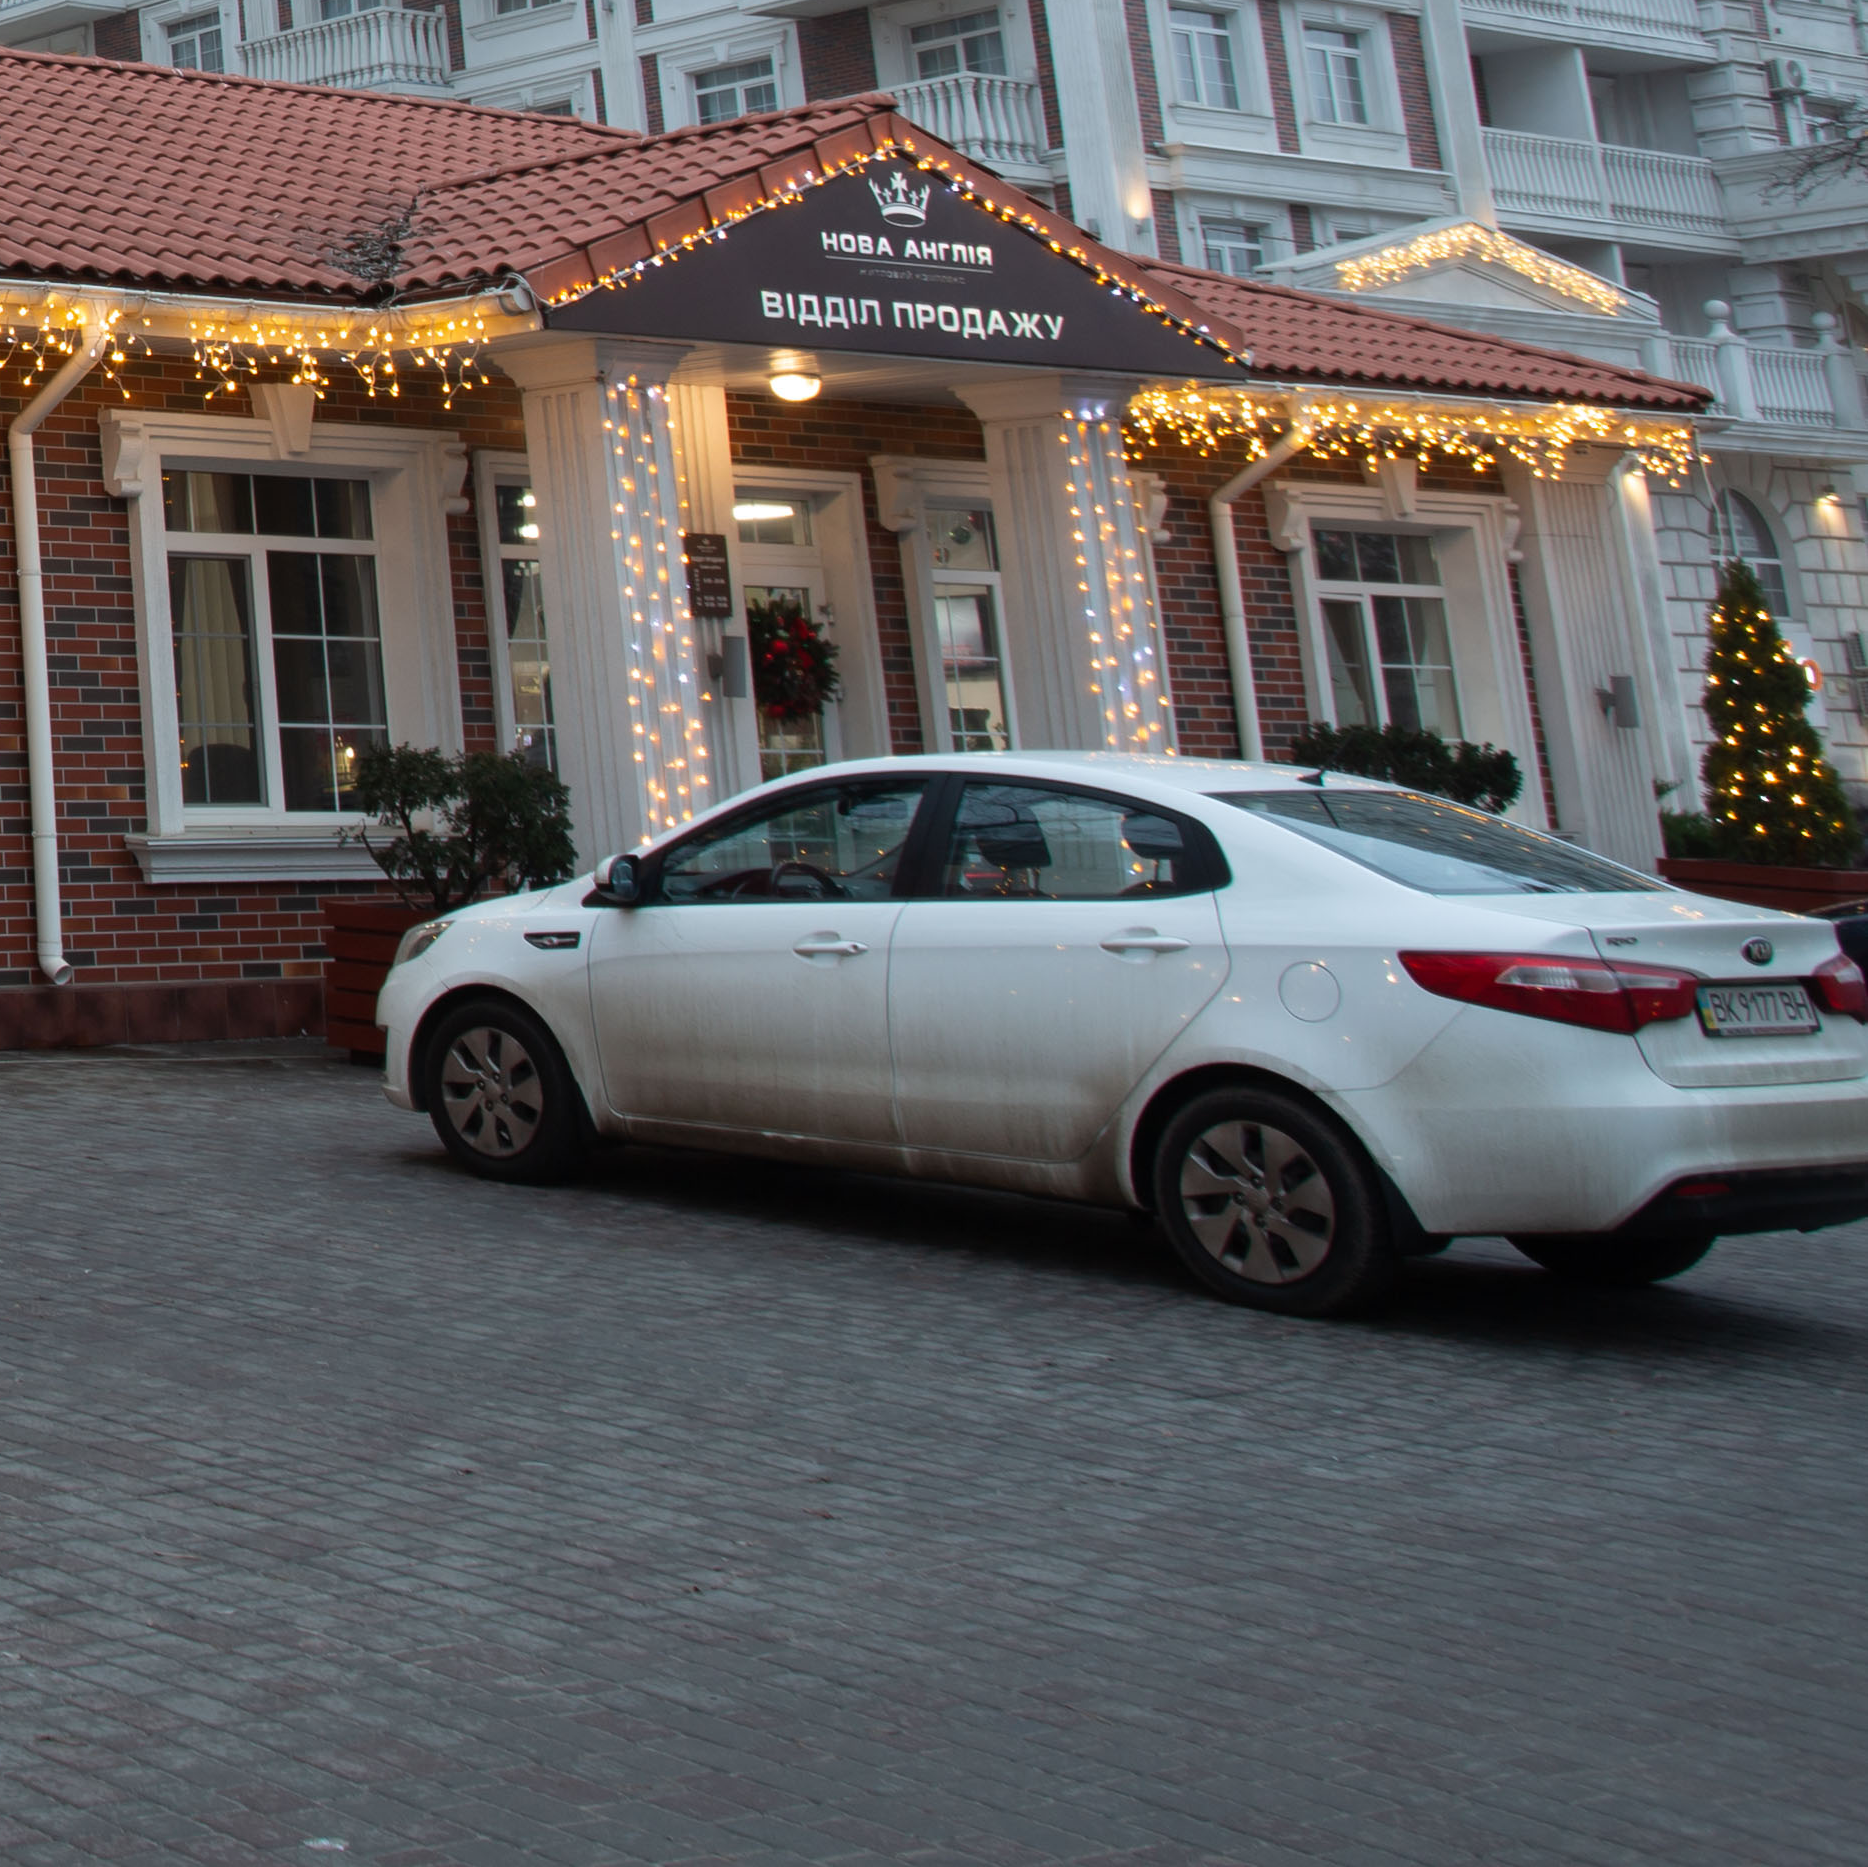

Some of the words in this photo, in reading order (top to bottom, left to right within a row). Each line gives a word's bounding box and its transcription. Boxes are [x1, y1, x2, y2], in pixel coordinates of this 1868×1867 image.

[821, 231, 894, 257] НОВА
[903, 238, 994, 266] АНГЛІЯ
[759, 289, 883, 330] ВІДДІЛ
[892, 300, 1065, 341] ПРОДАЖУ
[1739, 990, 1778, 1022] 9177
[1779, 989, 1813, 1021] BH
